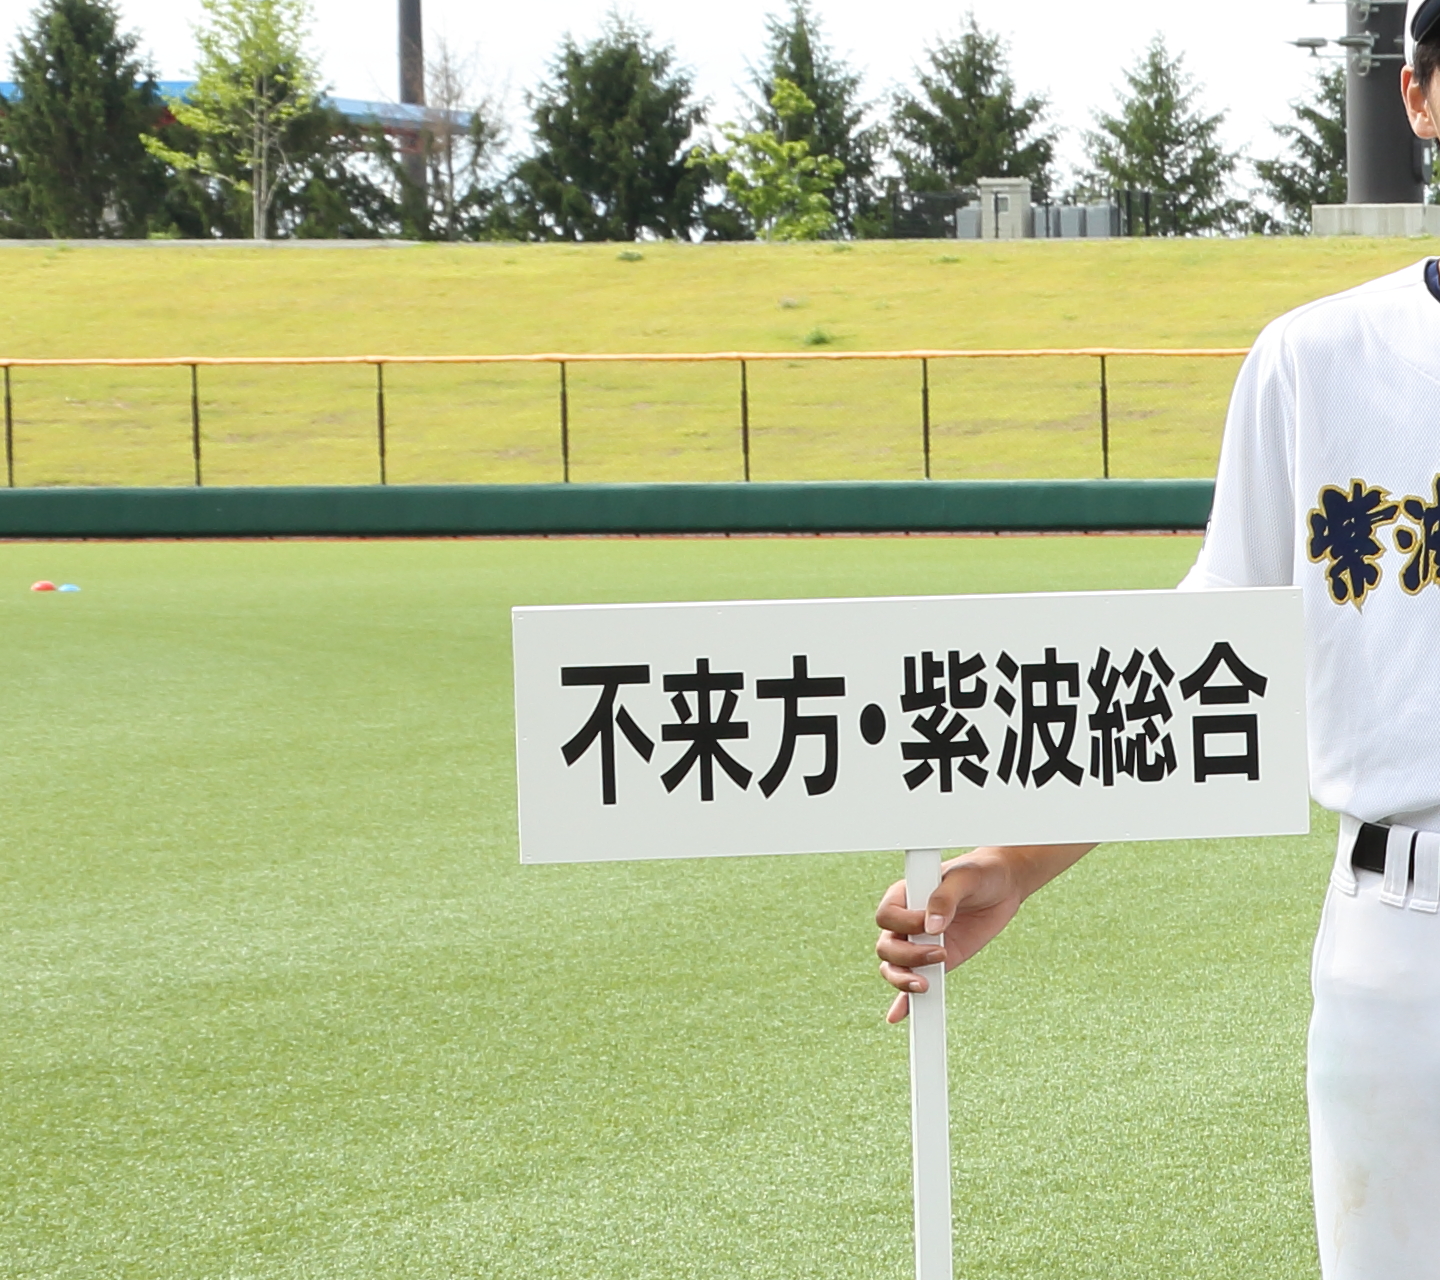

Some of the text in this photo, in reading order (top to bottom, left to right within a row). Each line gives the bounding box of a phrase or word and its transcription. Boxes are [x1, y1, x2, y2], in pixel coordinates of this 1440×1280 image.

[561, 642, 1267, 804] 不来方・紫波総合
